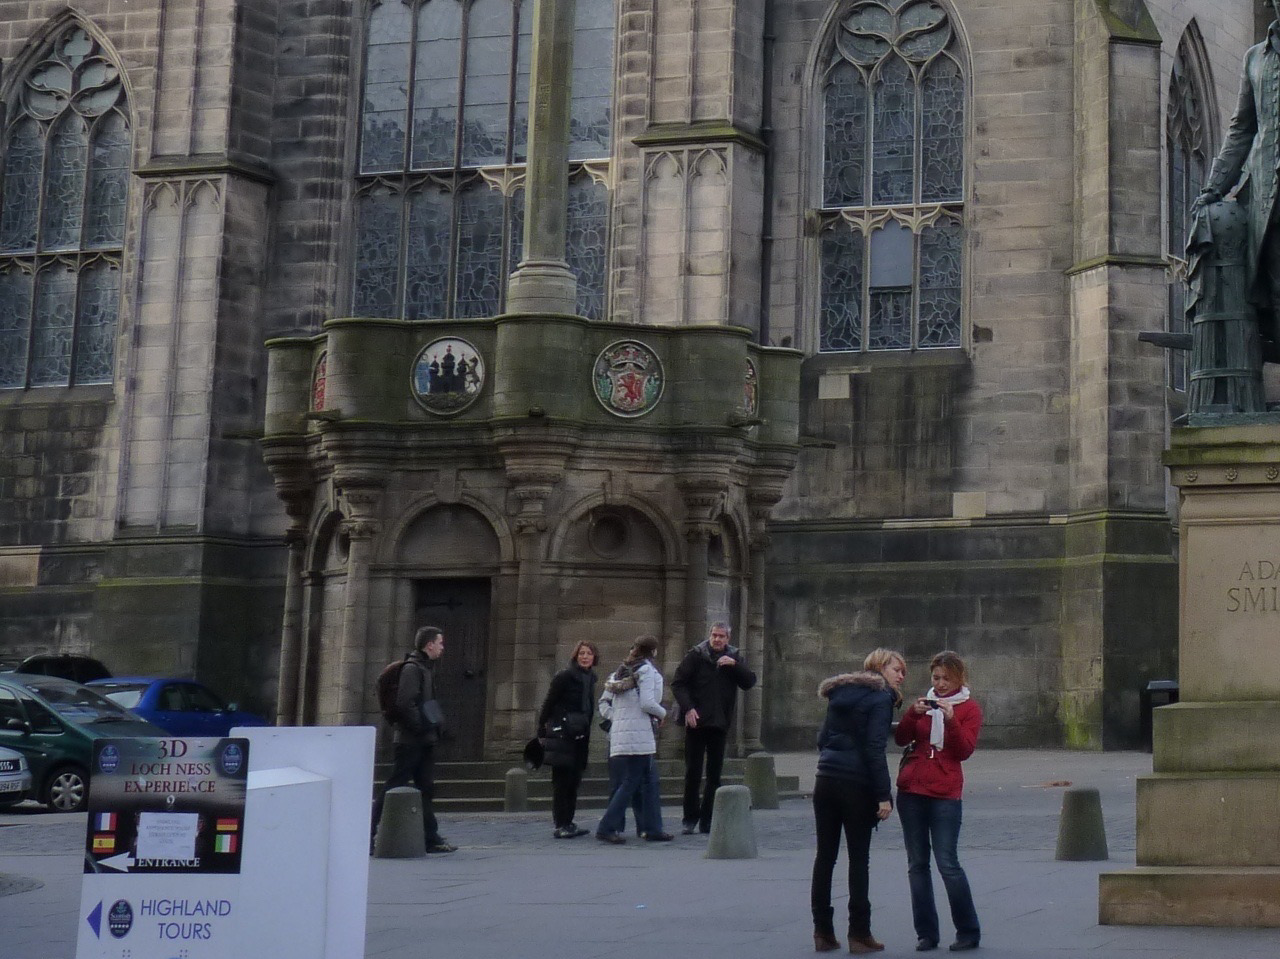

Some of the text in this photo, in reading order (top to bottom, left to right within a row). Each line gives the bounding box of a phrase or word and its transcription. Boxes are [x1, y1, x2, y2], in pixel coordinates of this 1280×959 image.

[157, 739, 188, 760] 3D
[131, 762, 211, 775] LOCH NESS
[124, 780, 216, 793] EXPERIENCE
[140, 899, 232, 917] HIGHLAND
[158, 922, 212, 940] TOURS
